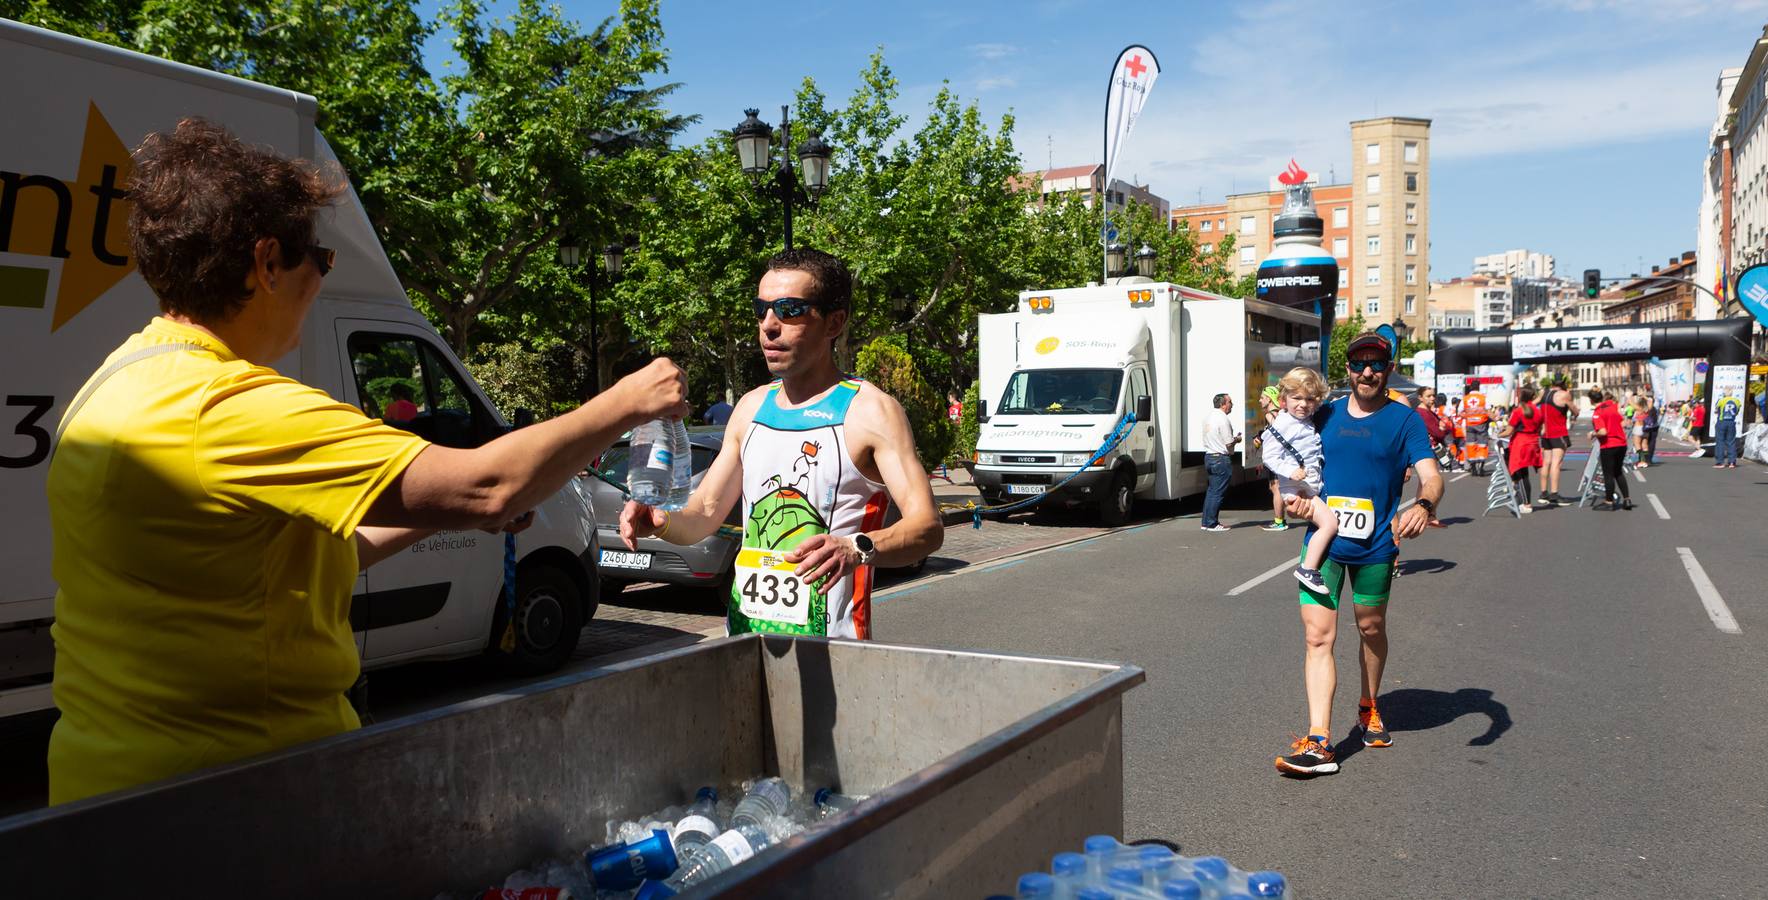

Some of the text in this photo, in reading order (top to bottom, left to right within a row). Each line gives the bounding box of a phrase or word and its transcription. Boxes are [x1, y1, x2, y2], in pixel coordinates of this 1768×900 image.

[1257, 275, 1320, 288] POWERADE
[1545, 336, 1614, 352] META
[1724, 403, 1736, 416] R
[412, 536, 477, 553] de Vehículos
[603, 551, 628, 564] 2460
[630, 553, 648, 566] JGC
[742, 572, 799, 608] 433
